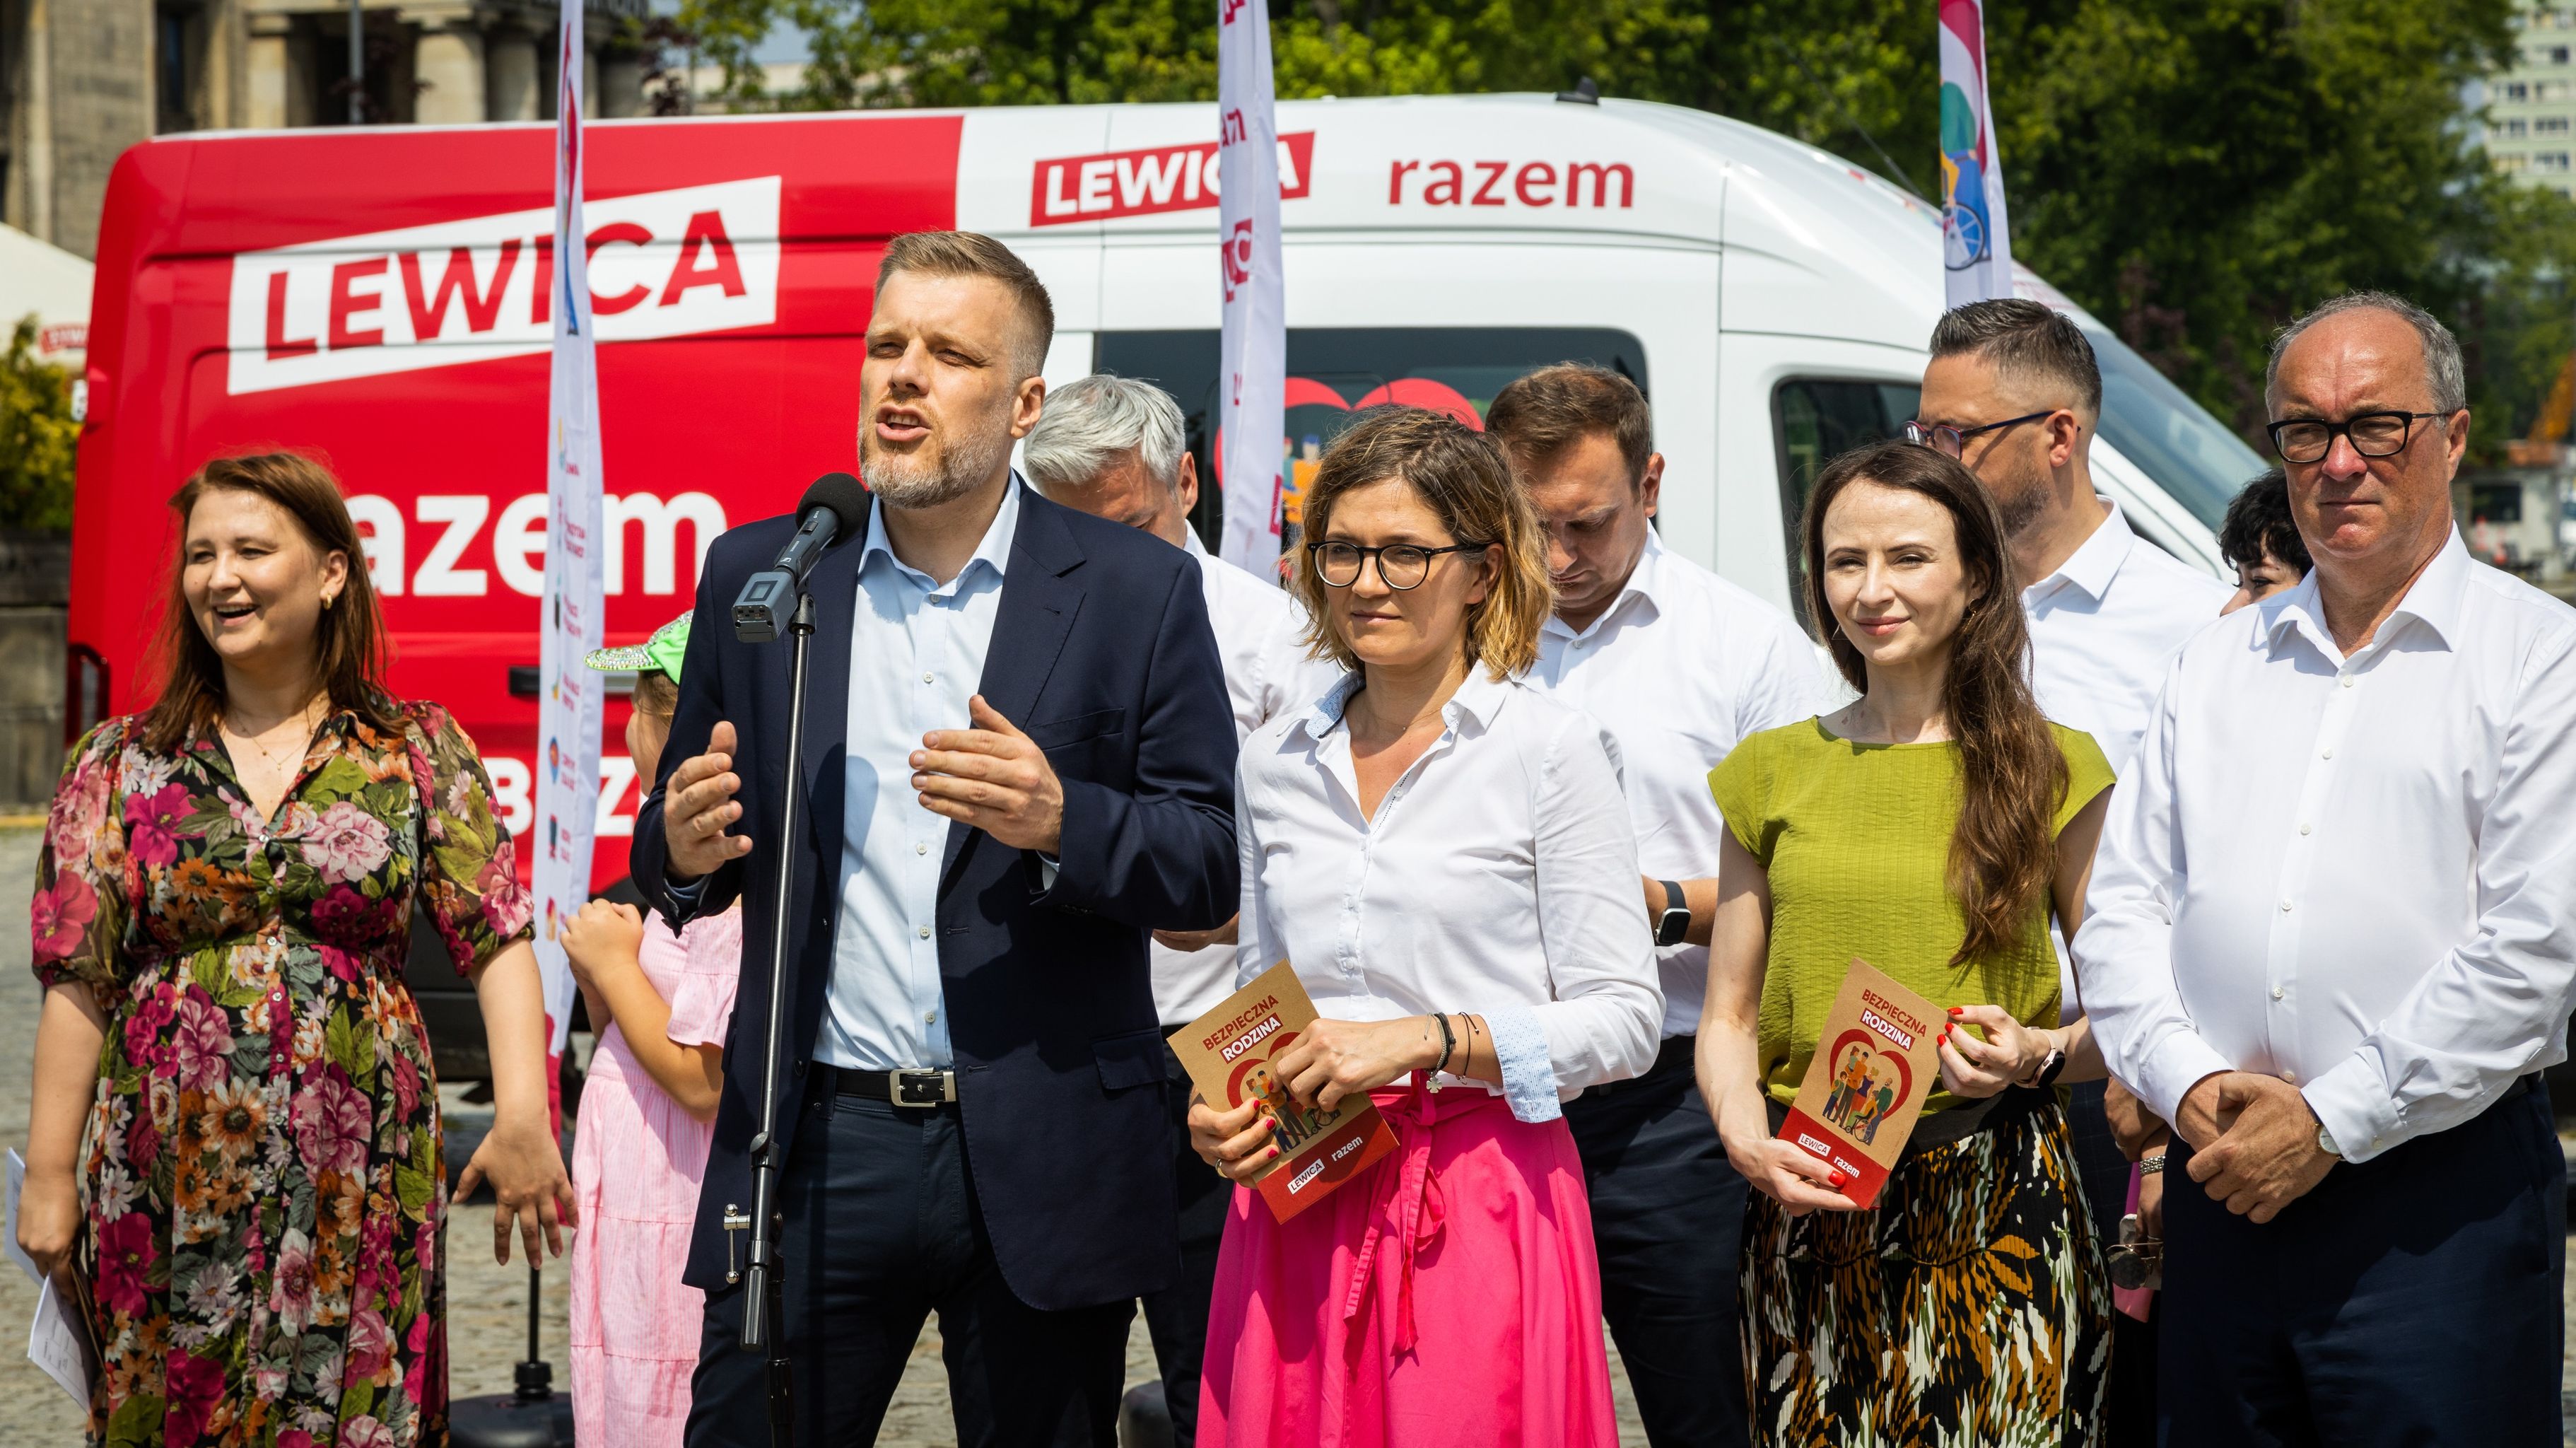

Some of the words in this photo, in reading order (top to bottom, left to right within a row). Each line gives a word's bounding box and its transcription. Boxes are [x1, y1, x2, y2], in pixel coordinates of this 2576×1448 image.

[1389, 160, 1634, 208] razem
[342, 492, 727, 597] azem
[1202, 994, 1279, 1051] BEZPIECZNA
[1861, 1010, 1911, 1050] RODZINA
[1862, 988, 1927, 1037] BEZPIECZNA
[1222, 1016, 1282, 1061] RODZINA
[1290, 1162, 1322, 1191] LEWICA
[1331, 1136, 1364, 1162] razem
[1801, 1135, 1828, 1155] LEWICA
[1833, 1155, 1861, 1179] razem
